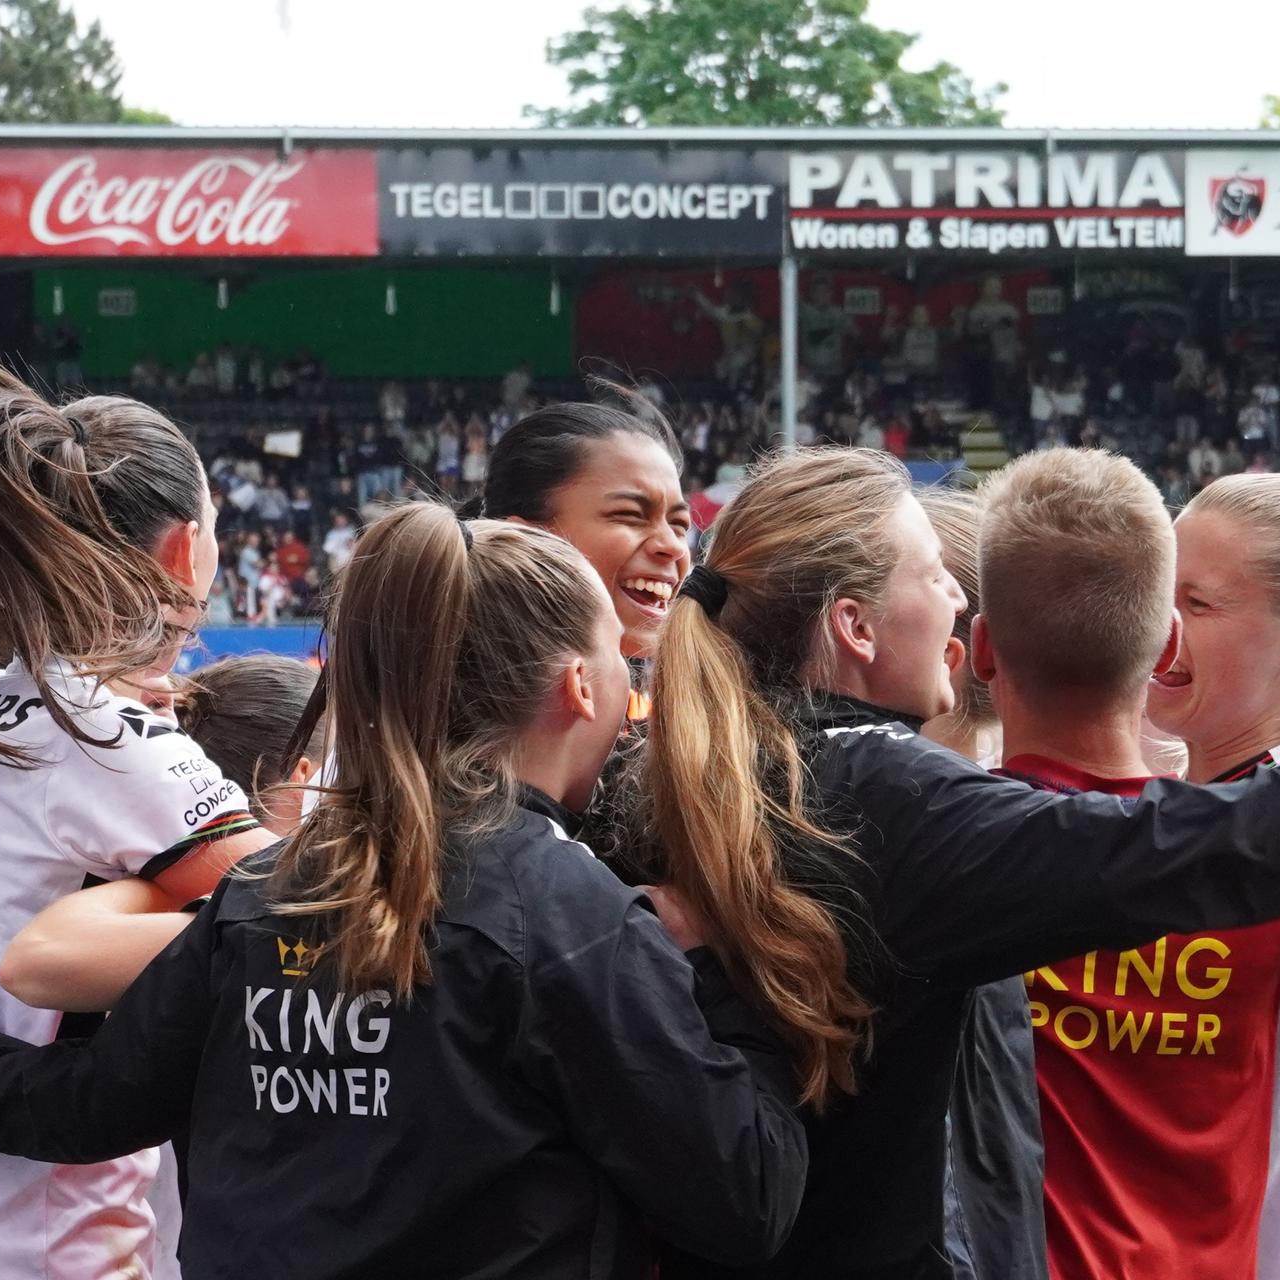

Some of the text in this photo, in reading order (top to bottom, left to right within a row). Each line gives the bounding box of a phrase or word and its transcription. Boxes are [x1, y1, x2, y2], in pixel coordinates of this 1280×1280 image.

[30, 153, 301, 246] Coca-Cola
[389, 183, 773, 220] TEGEL CONCEPT
[788, 153, 1183, 208] PATRIMA
[790, 217, 1184, 254] Wonen & Slapen VELTEM
[245, 986, 392, 1055] KING
[1030, 1000, 1222, 1056] POWER
[250, 1064, 391, 1116] POWER
